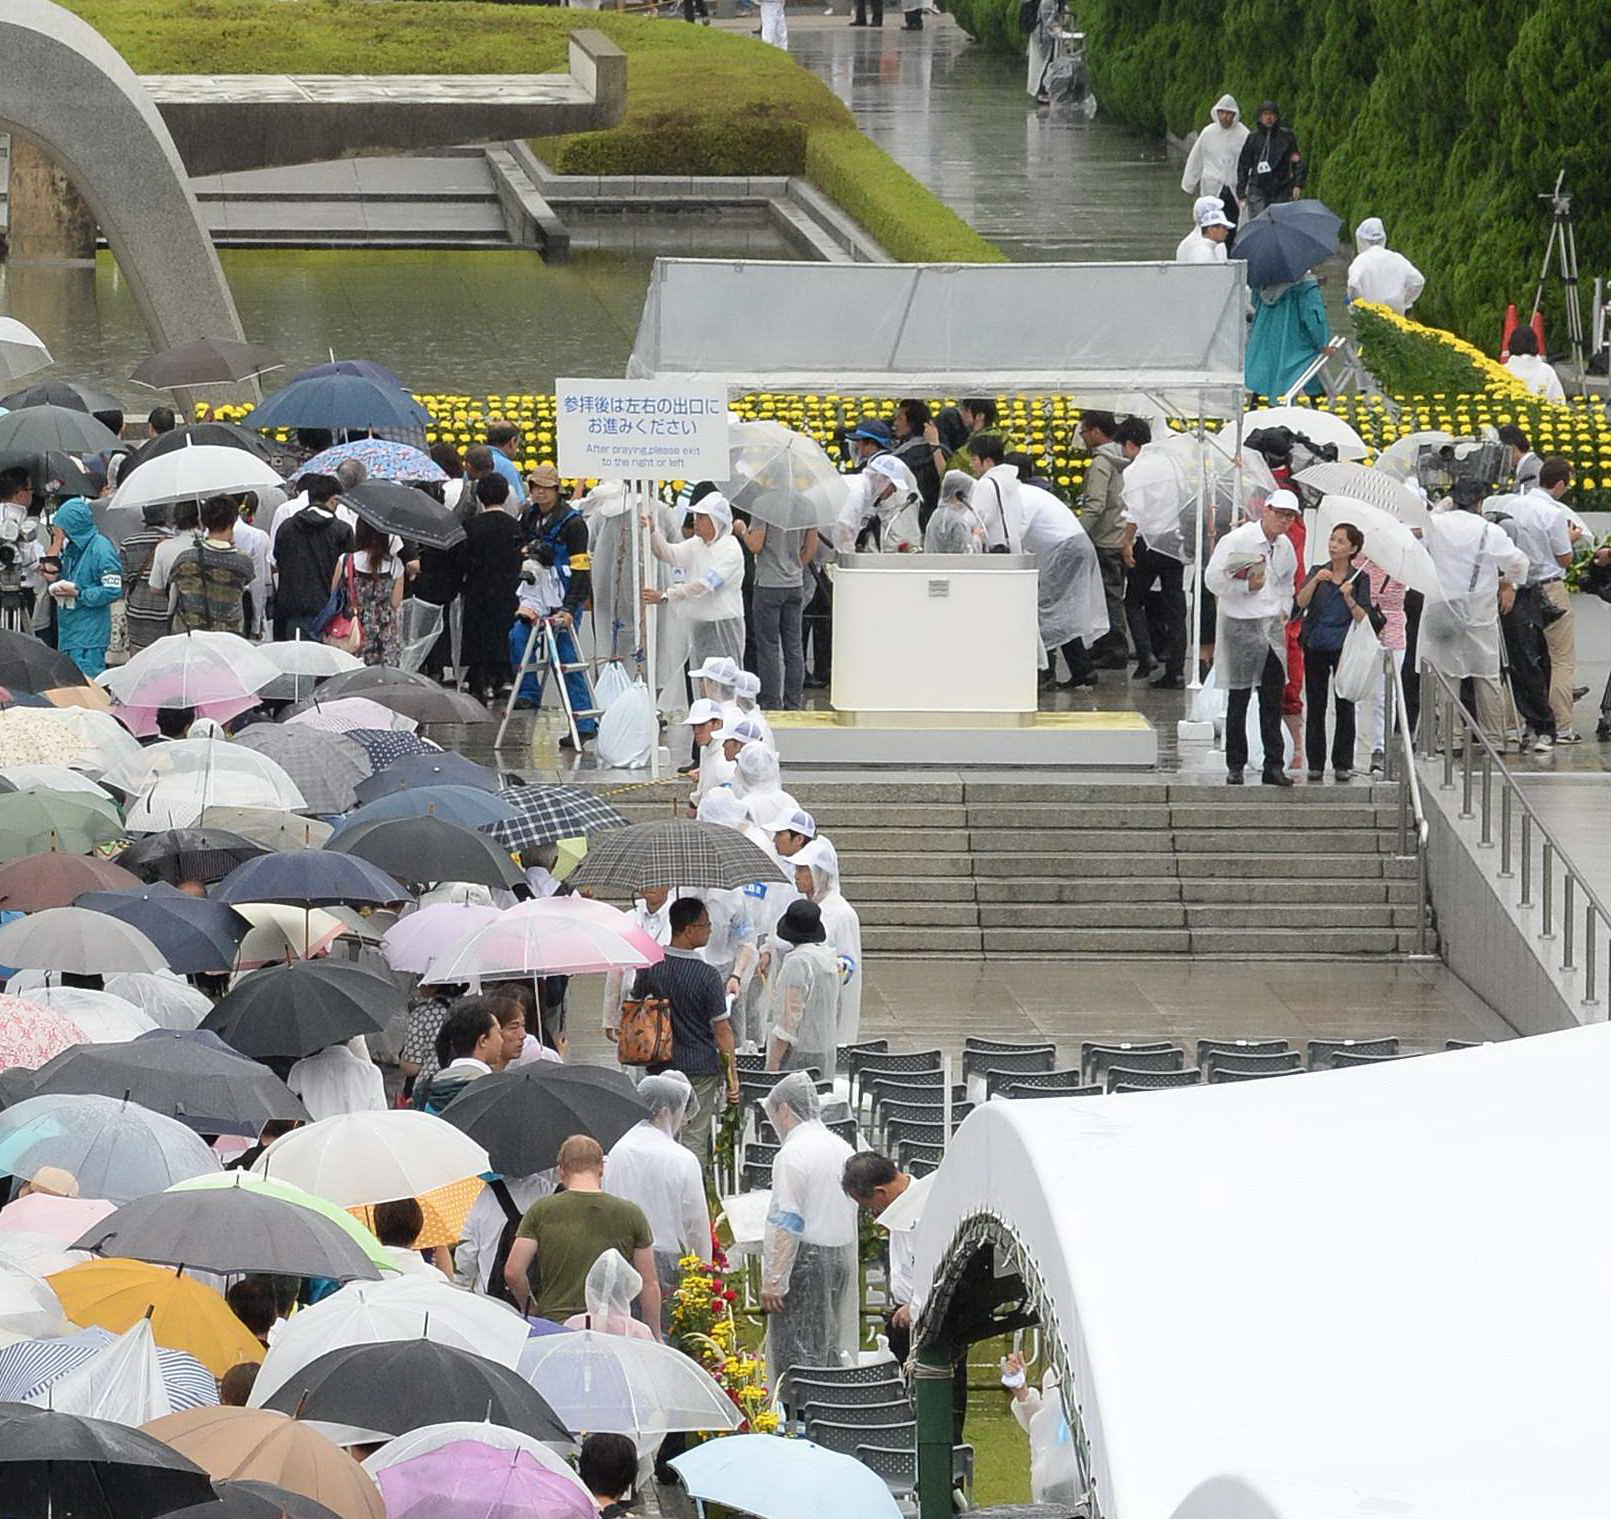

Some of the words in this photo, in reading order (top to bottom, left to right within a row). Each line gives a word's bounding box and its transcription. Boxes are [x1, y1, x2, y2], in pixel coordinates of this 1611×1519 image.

[563, 395, 719, 415] 参拝後は左右の出口に
[588, 418, 697, 435] お進みください
[586, 444, 609, 454] After
[682, 446, 700, 456] exit
[602, 457, 611, 466] to
[614, 457, 629, 467] the
[631, 457, 654, 469] right
[669, 458, 684, 468] left
